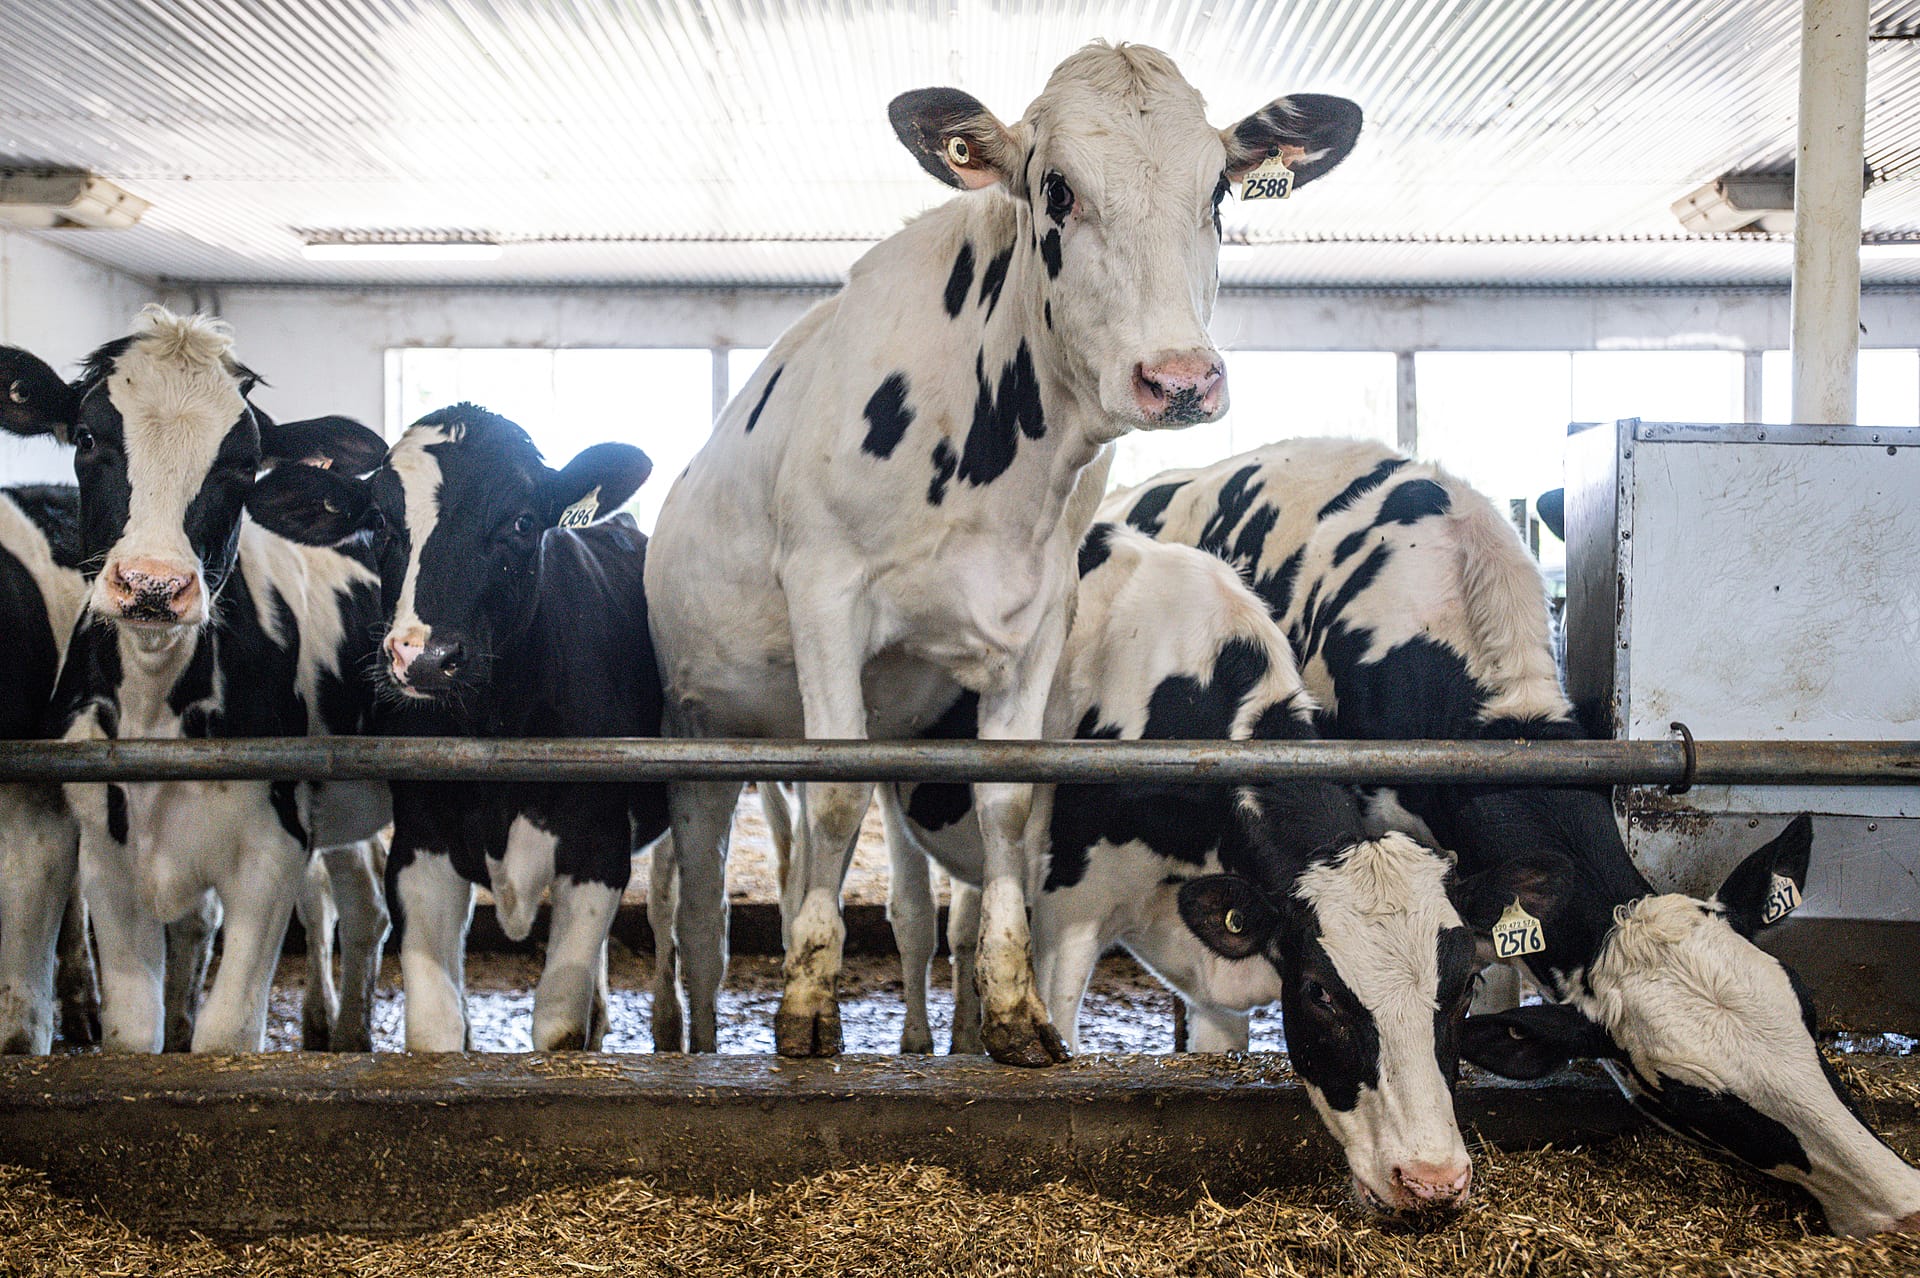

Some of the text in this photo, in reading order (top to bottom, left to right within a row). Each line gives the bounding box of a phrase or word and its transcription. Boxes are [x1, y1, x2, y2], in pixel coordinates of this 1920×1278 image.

[1244, 178, 1288, 200] 2588
[561, 508, 593, 528] 2496
[1498, 926, 1541, 956] 2576
